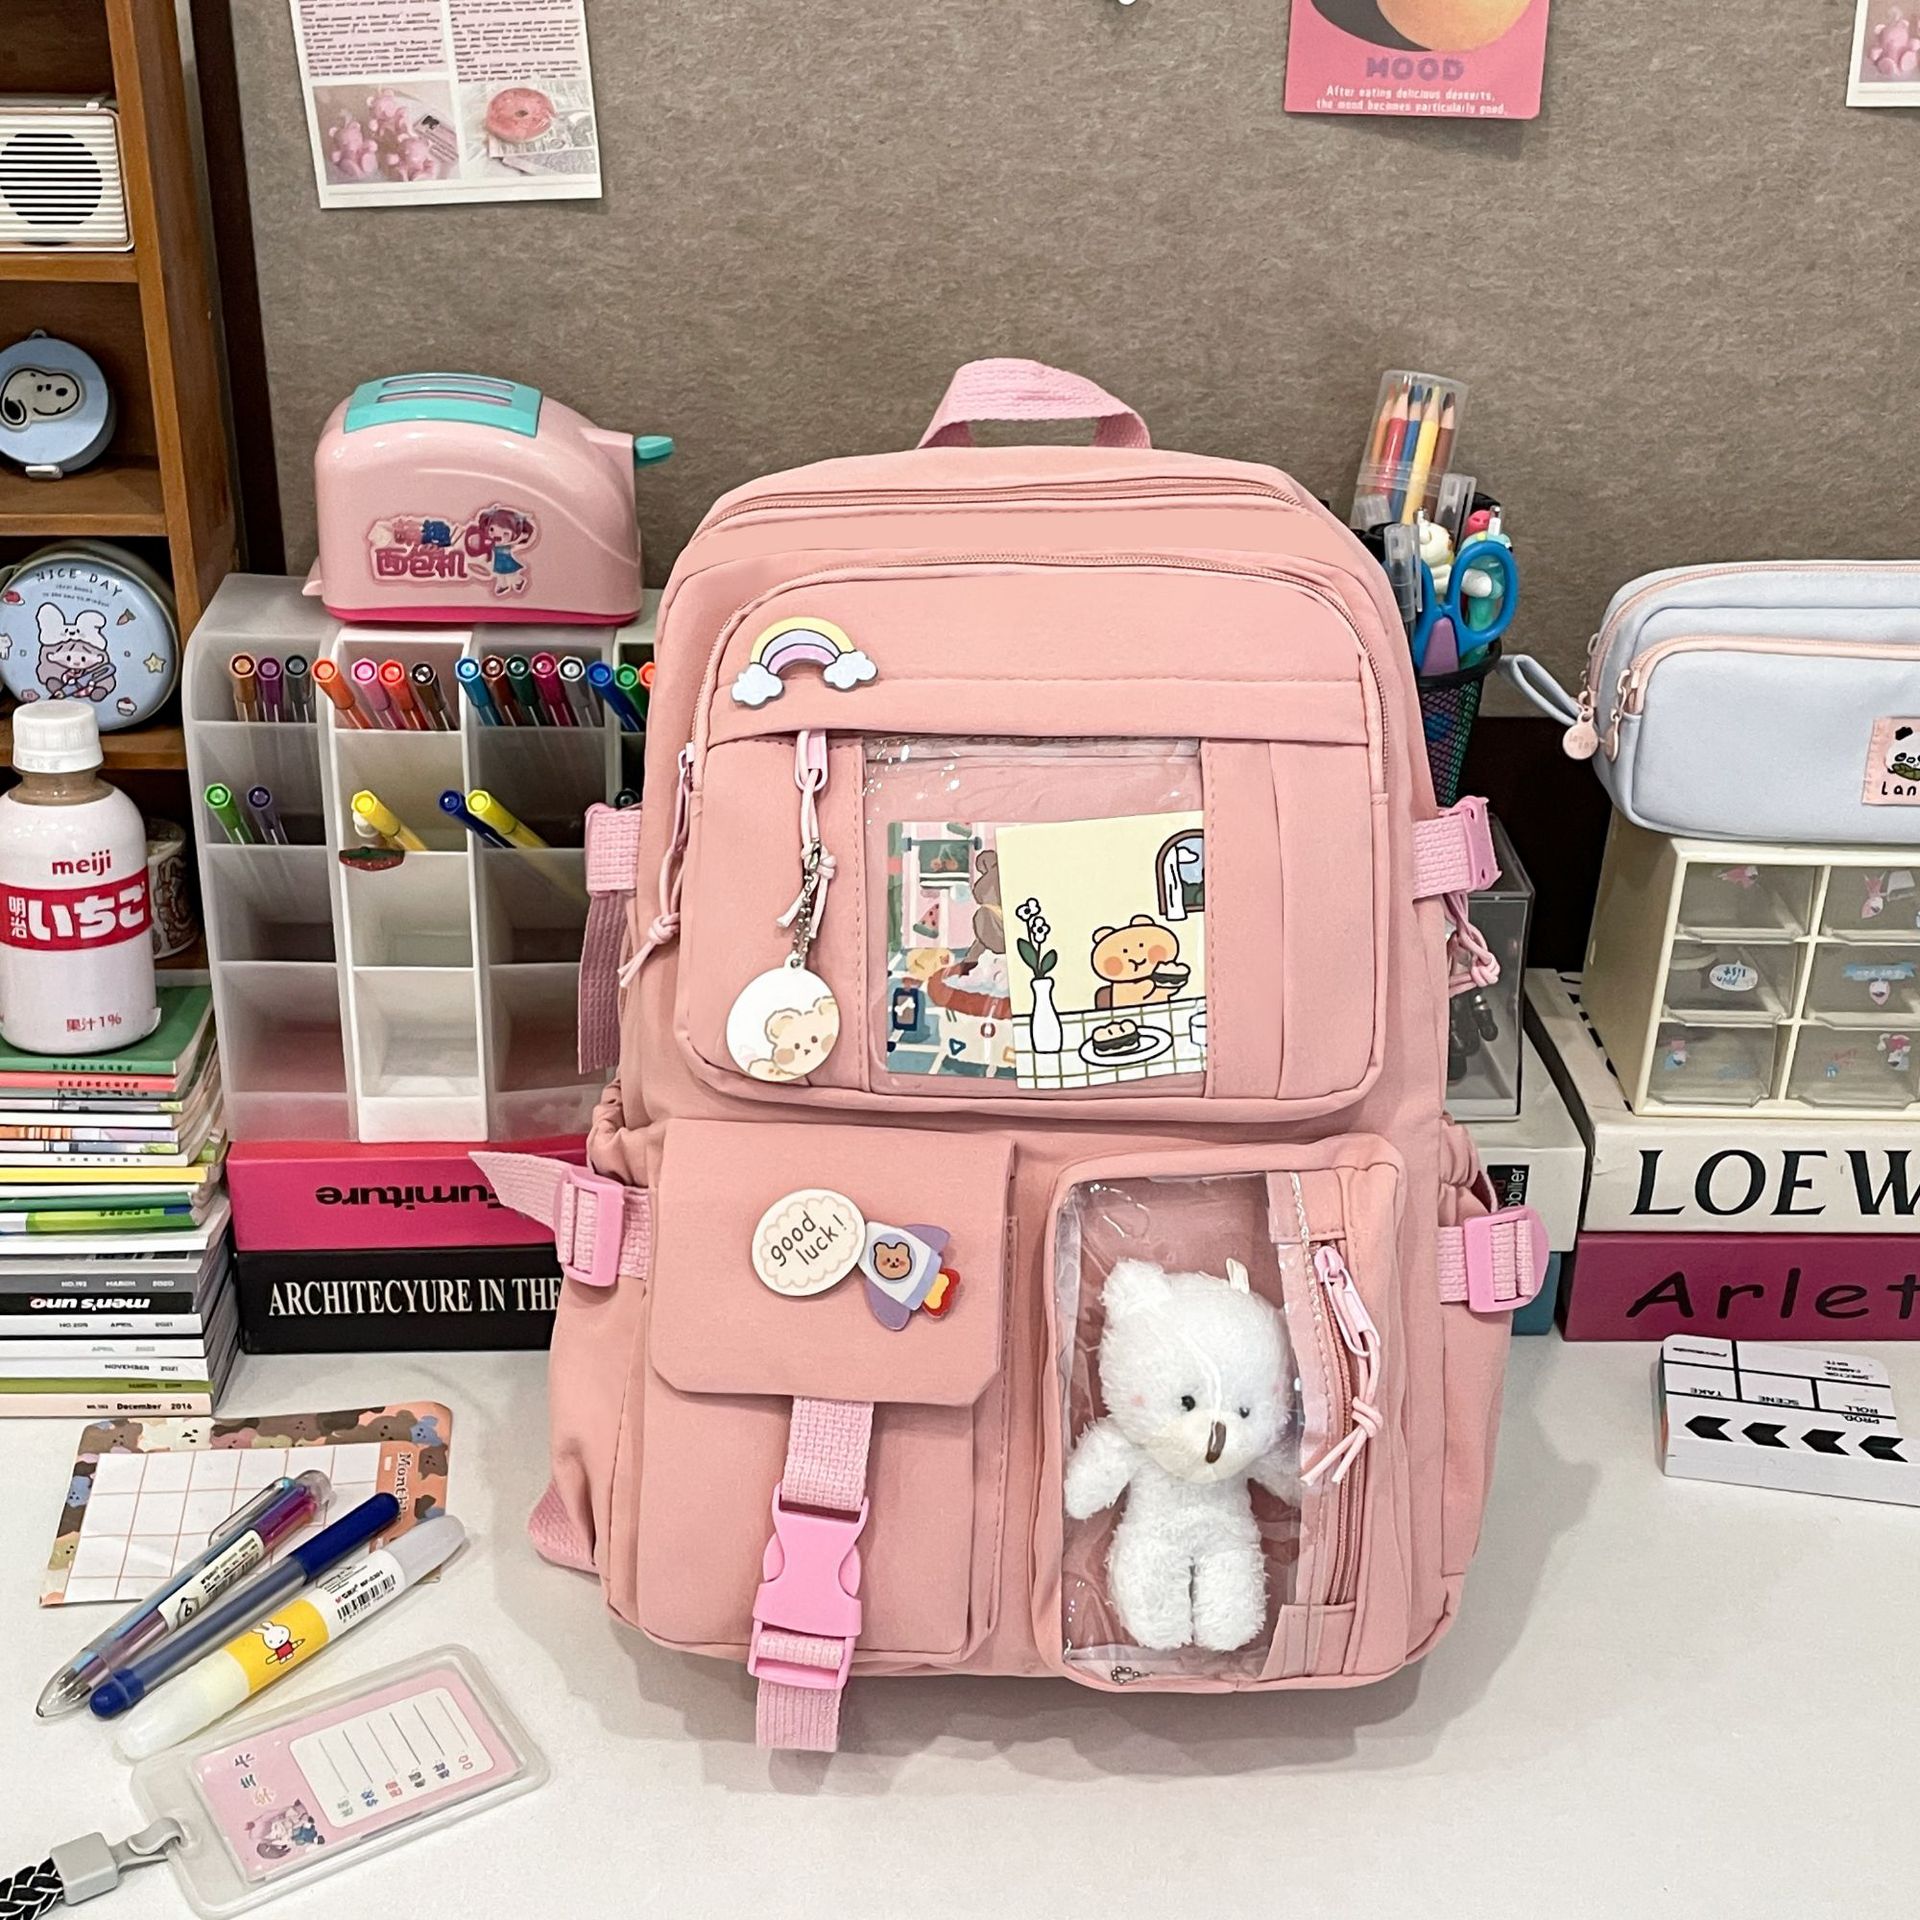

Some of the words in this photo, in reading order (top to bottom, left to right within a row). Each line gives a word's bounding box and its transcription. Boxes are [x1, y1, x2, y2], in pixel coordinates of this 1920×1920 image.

[1366, 57, 1465, 81] MOOD
[1326, 85, 1355, 97] After
[1359, 87, 1392, 99] eating
[1396, 88, 1441, 99] delicious
[1445, 88, 1495, 101] desserts,
[1316, 99, 1333, 109] the
[1337, 100, 1364, 110] mood
[1367, 101, 1411, 112] becomes
[1416, 102, 1475, 114] particularly
[36, 568, 79, 582] NICE
[89, 573, 122, 596] DAY
[52, 850, 112, 876] meiji
[8, 895, 28, 939] 明治
[1630, 1149, 1920, 1216] LOEW
[770, 1210, 816, 1267] good
[105, 1280, 136, 1288] MARCH
[268, 1280, 473, 1316] ARCHITECYURE
[478, 1279, 506, 1312] IN
[511, 1277, 562, 1312] THE
[1625, 1267, 1920, 1319] Arlet
[30, 1298, 77, 1309] uno
[81, 1298, 150, 1311] men's
[105, 1363, 150, 1371] NOVEMBER
[1690, 1387, 1724, 1398] TAKE
[116, 1402, 162, 1410] December
[171, 1402, 193, 1410] 2016
[1758, 1395, 1800, 1406] SCENE
[1844, 1404, 1879, 1414] ROLL
